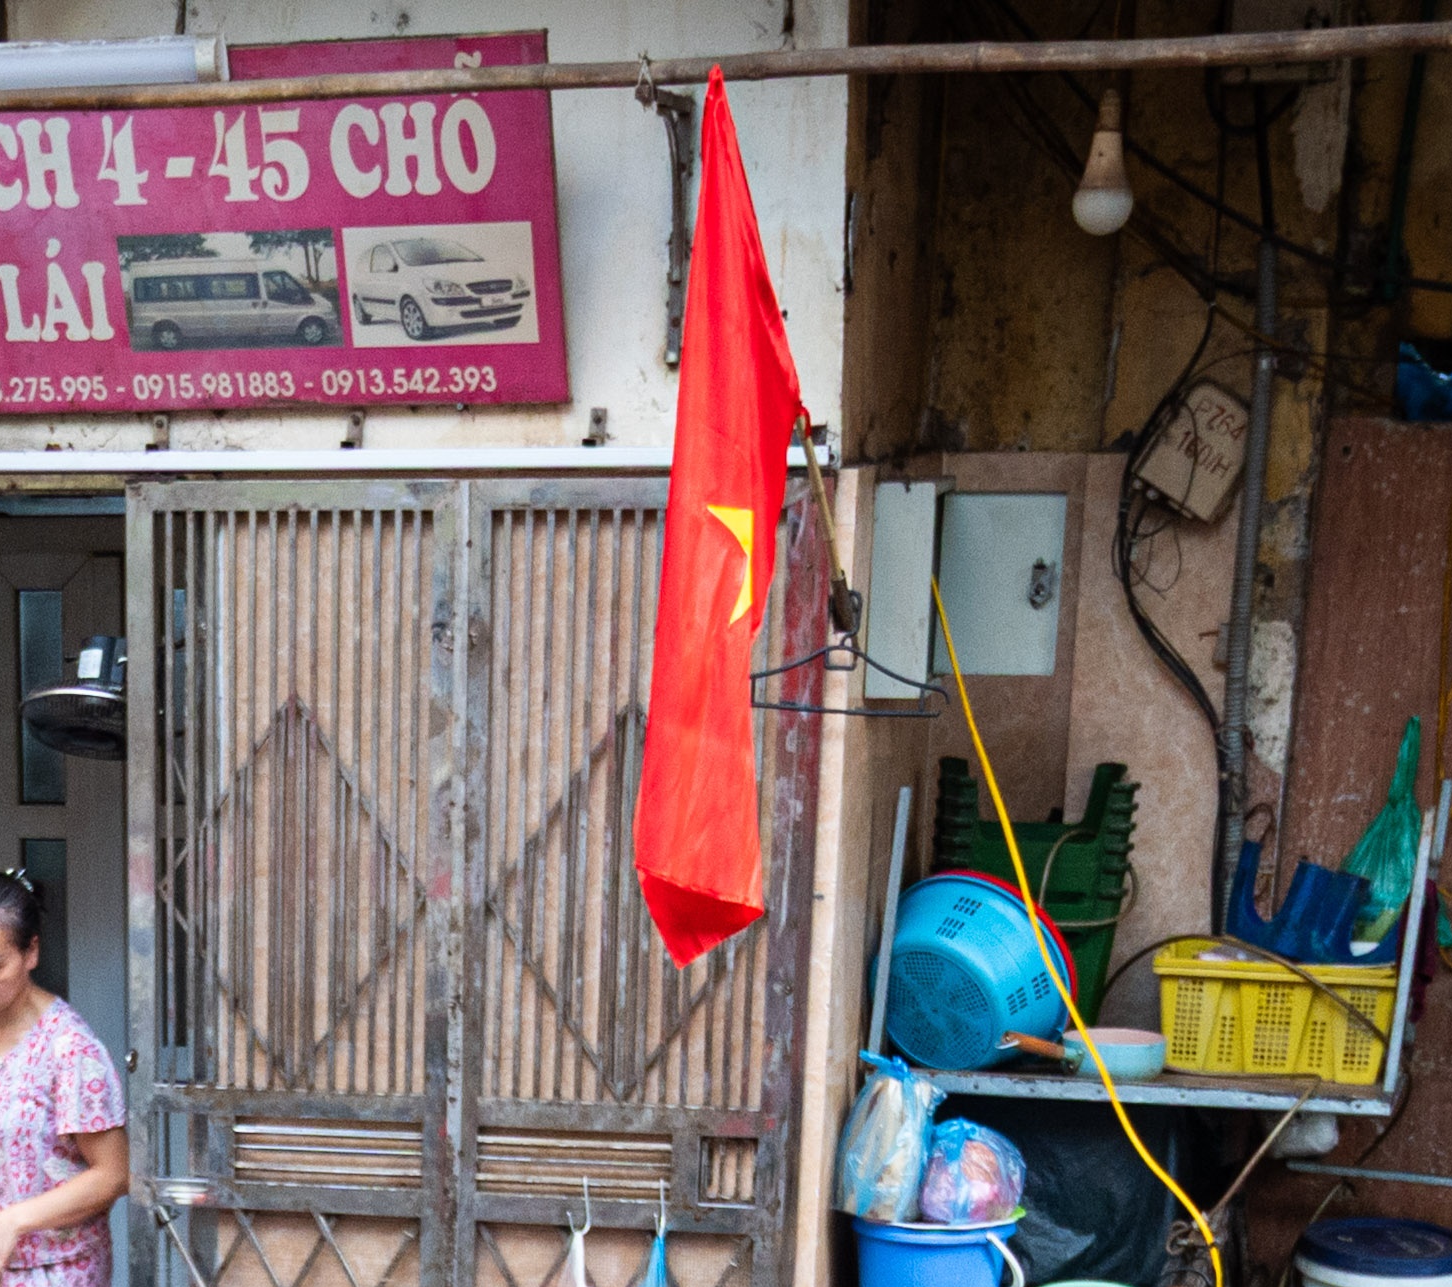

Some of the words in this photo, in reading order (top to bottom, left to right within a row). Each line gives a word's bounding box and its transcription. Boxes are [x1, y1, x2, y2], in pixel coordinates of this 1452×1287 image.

[98, 115, 149, 206] 4
[209, 107, 310, 202] 45
[329, 51, 497, 198] CHỖ
[133, 371, 296, 401] 0915.981883
[322, 366, 498, 396] 0913.542.393
